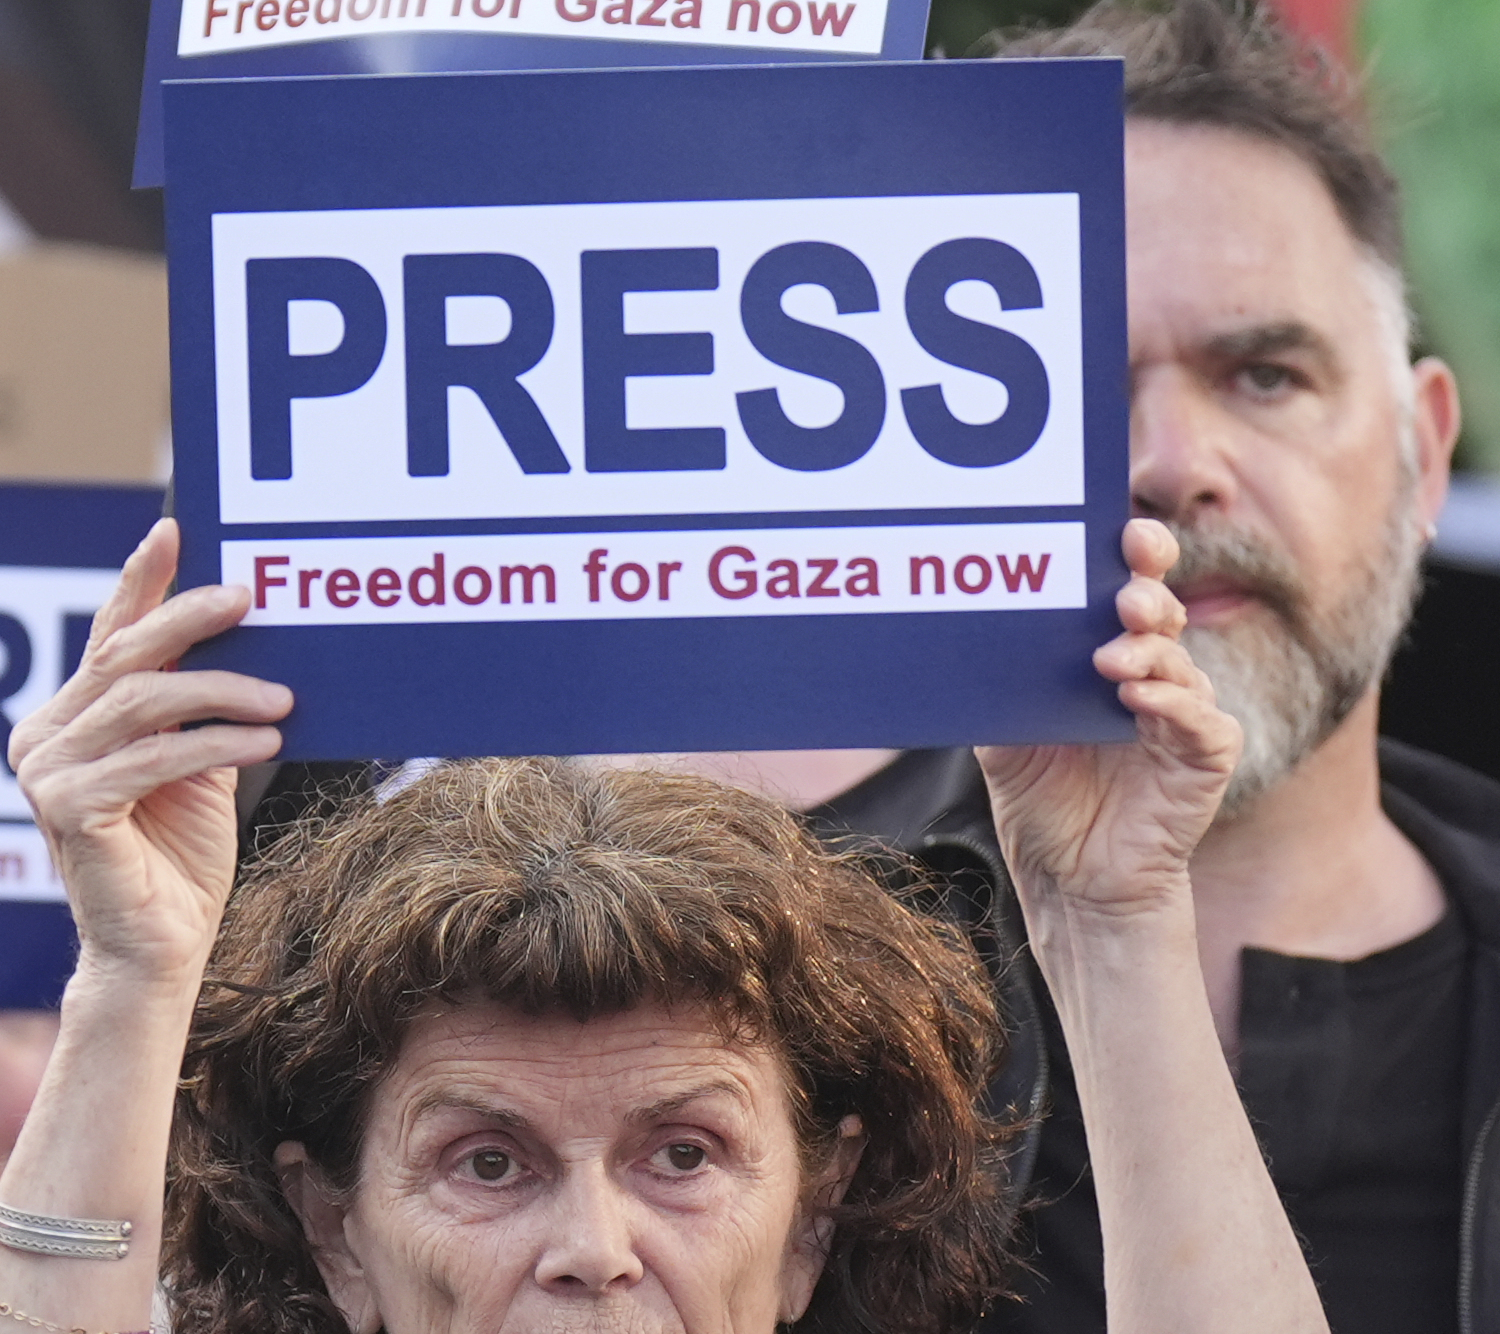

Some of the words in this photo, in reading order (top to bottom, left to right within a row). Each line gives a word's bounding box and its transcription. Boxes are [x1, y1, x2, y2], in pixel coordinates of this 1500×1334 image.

[244, 235, 1052, 481] PRESS
[252, 550, 558, 609] Freedom
[582, 547, 682, 602] for
[707, 544, 881, 599] Gaza
[909, 547, 1052, 593] now
